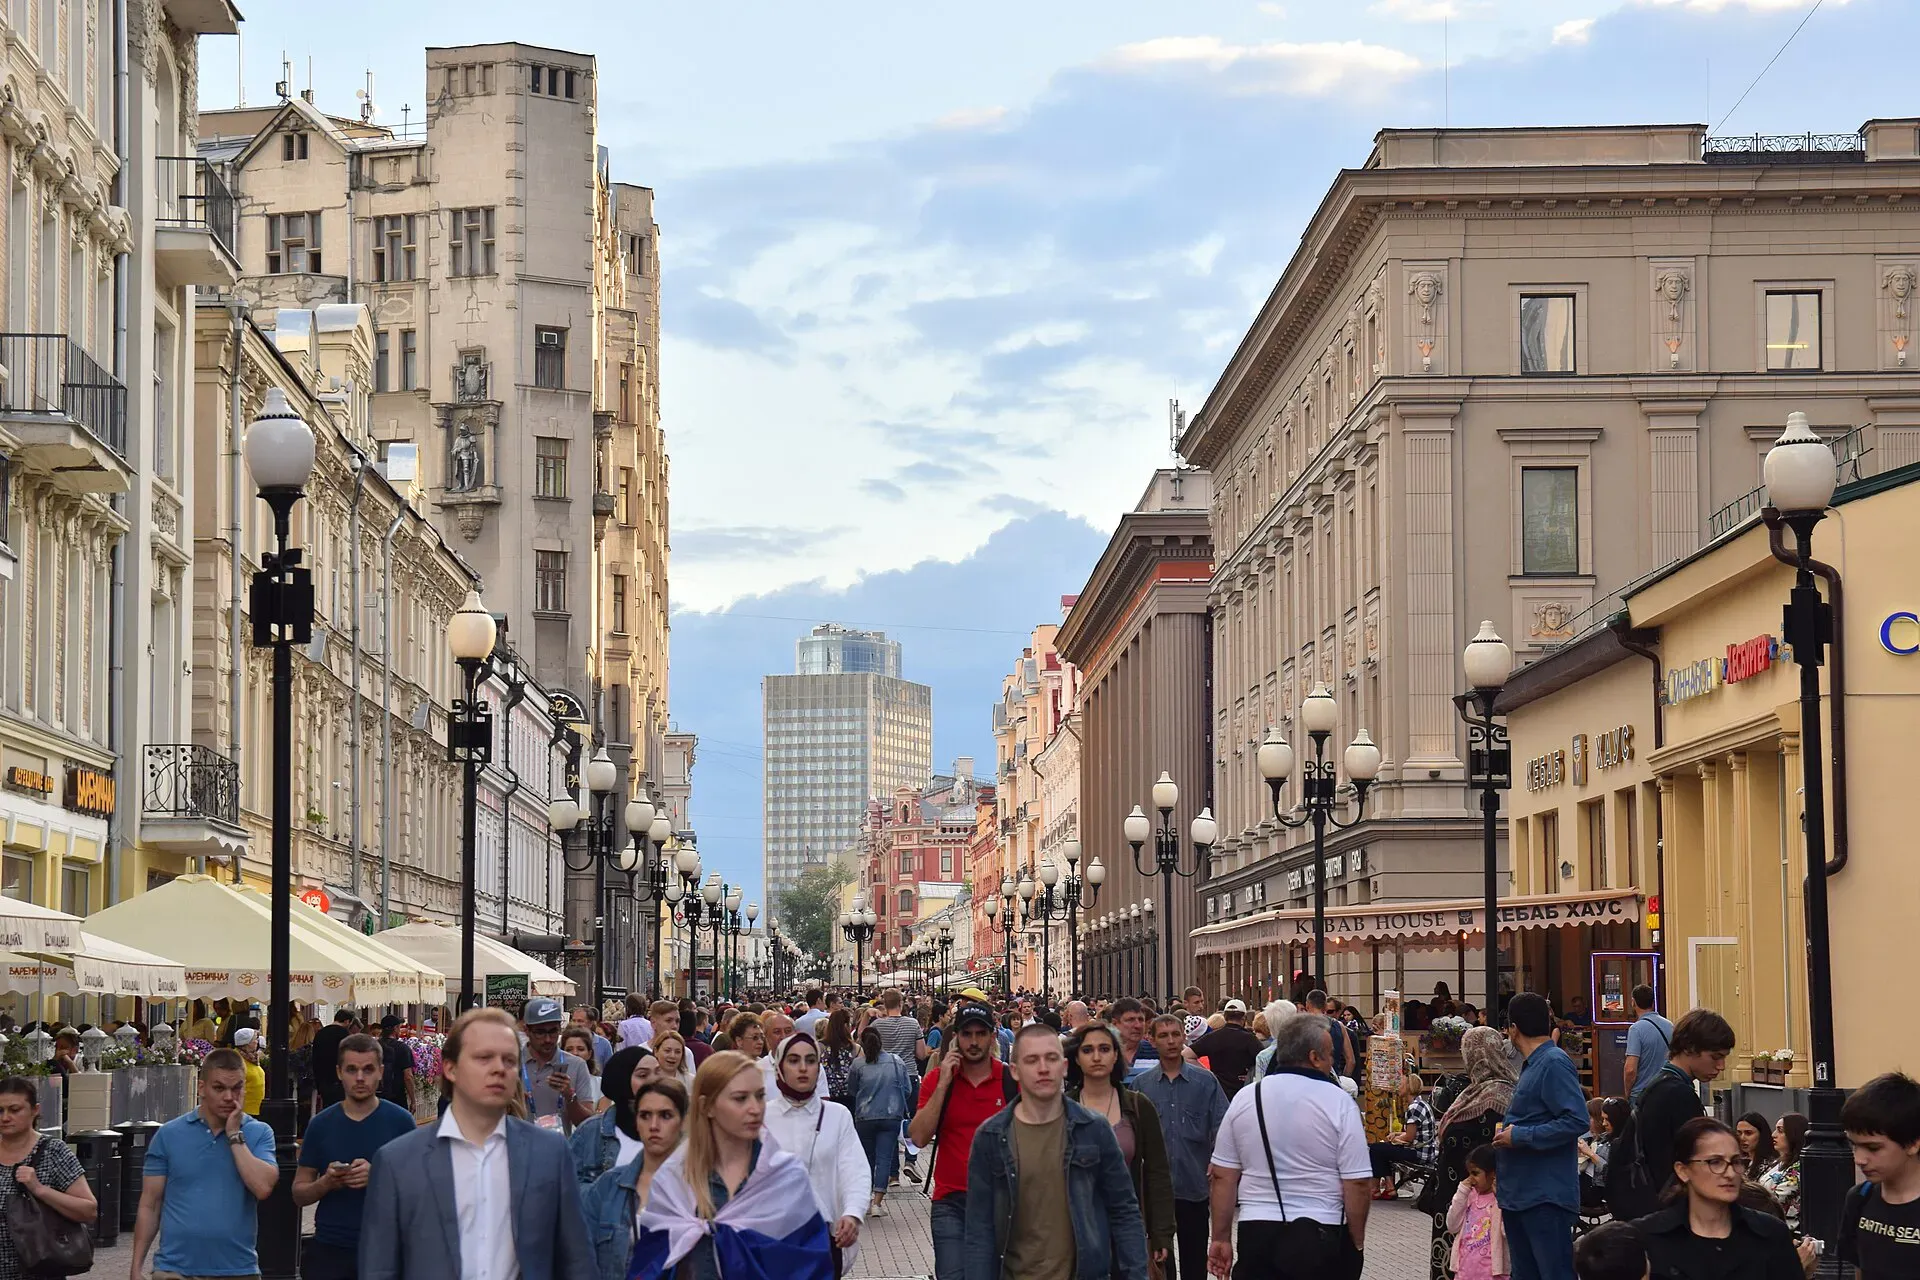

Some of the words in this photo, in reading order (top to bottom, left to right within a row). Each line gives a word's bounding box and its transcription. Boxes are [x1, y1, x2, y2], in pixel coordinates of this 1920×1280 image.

[1726, 635, 1771, 684] ХЕСБУРГЕР
[1668, 657, 1716, 706] СИННАБОН
[1595, 725, 1630, 770] ХАУС
[1526, 749, 1562, 792] КЕБАБ
[1375, 912, 1446, 930] HOUSE
[1566, 900, 1623, 918] ХАУС
[9, 966, 57, 976] ВАРЕНИНАЯ
